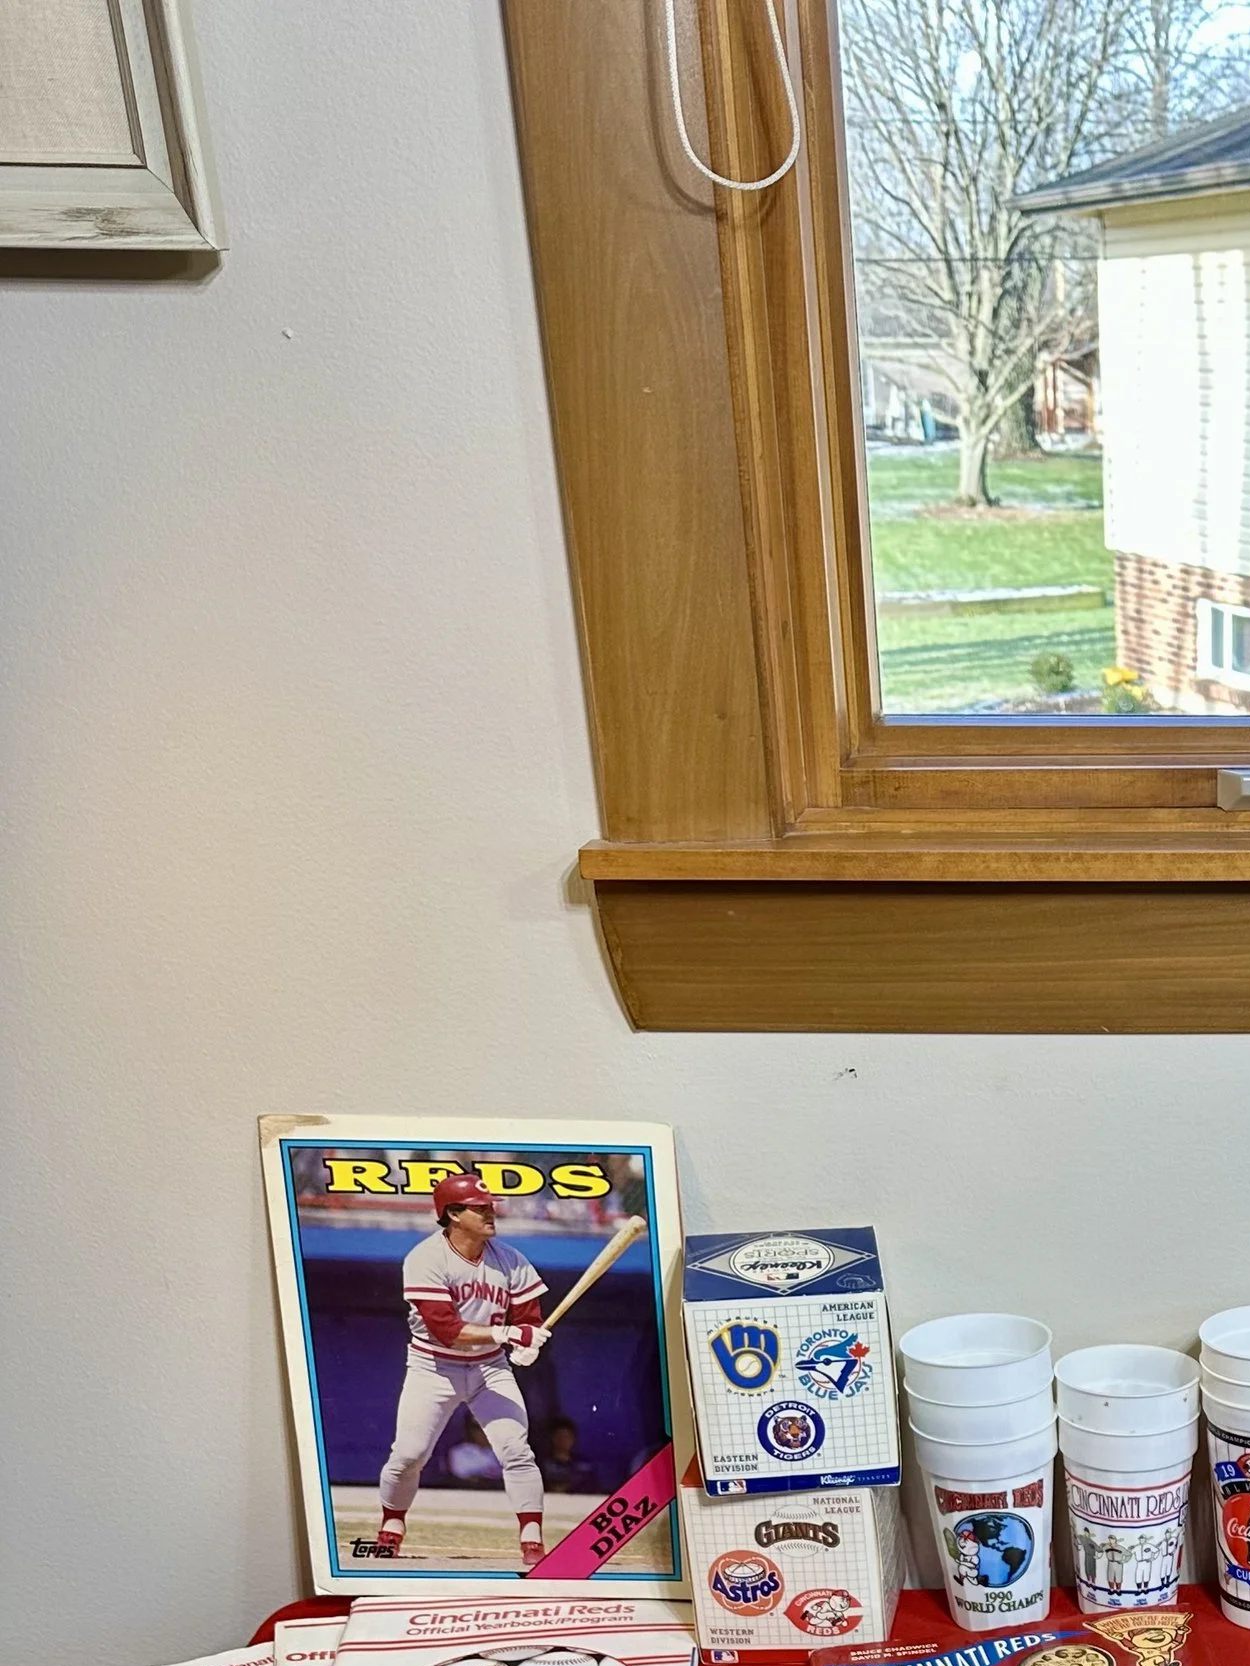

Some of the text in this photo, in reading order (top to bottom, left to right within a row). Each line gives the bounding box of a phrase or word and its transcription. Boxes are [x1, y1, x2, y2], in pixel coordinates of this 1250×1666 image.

[822, 1302, 874, 1312] AMERICAN
[837, 1313, 875, 1322] LEAGUE
[797, 1329, 849, 1358] TORONTO
[798, 1362, 873, 1400] BLUE JAYS
[765, 1402, 816, 1419] DETROIT
[714, 1454, 758, 1463] EASTERN
[773, 1446, 817, 1461] TIGERS
[714, 1464, 758, 1473] DIVISION
[1221, 1464, 1236, 1478] 19
[813, 1497, 860, 1505] NATIONAL
[1071, 1484, 1181, 1519] CINCINNATI REDS
[589, 1495, 630, 1535] BO
[825, 1506, 861, 1514] LEAGUE
[589, 1495, 658, 1561] DIAZ
[754, 1520, 840, 1548] GIANTS
[712, 1567, 780, 1604] Astros
[954, 1590, 1044, 1613] WORLD CHAMPS
[984, 1591, 1012, 1603] 1990
[409, 1603, 635, 1626] Cincinnati Reds
[406, 1614, 633, 1636] Official Yearbook/Program
[710, 1628, 754, 1636] WESTERN
[807, 1624, 841, 1636] REDS
[711, 1637, 752, 1645] DIVISION
[993, 1632, 1057, 1659] REDS
[850, 1643, 939, 1658] BRUCE CHADWICK
[851, 1648, 937, 1662] DAVID SPINDEL
